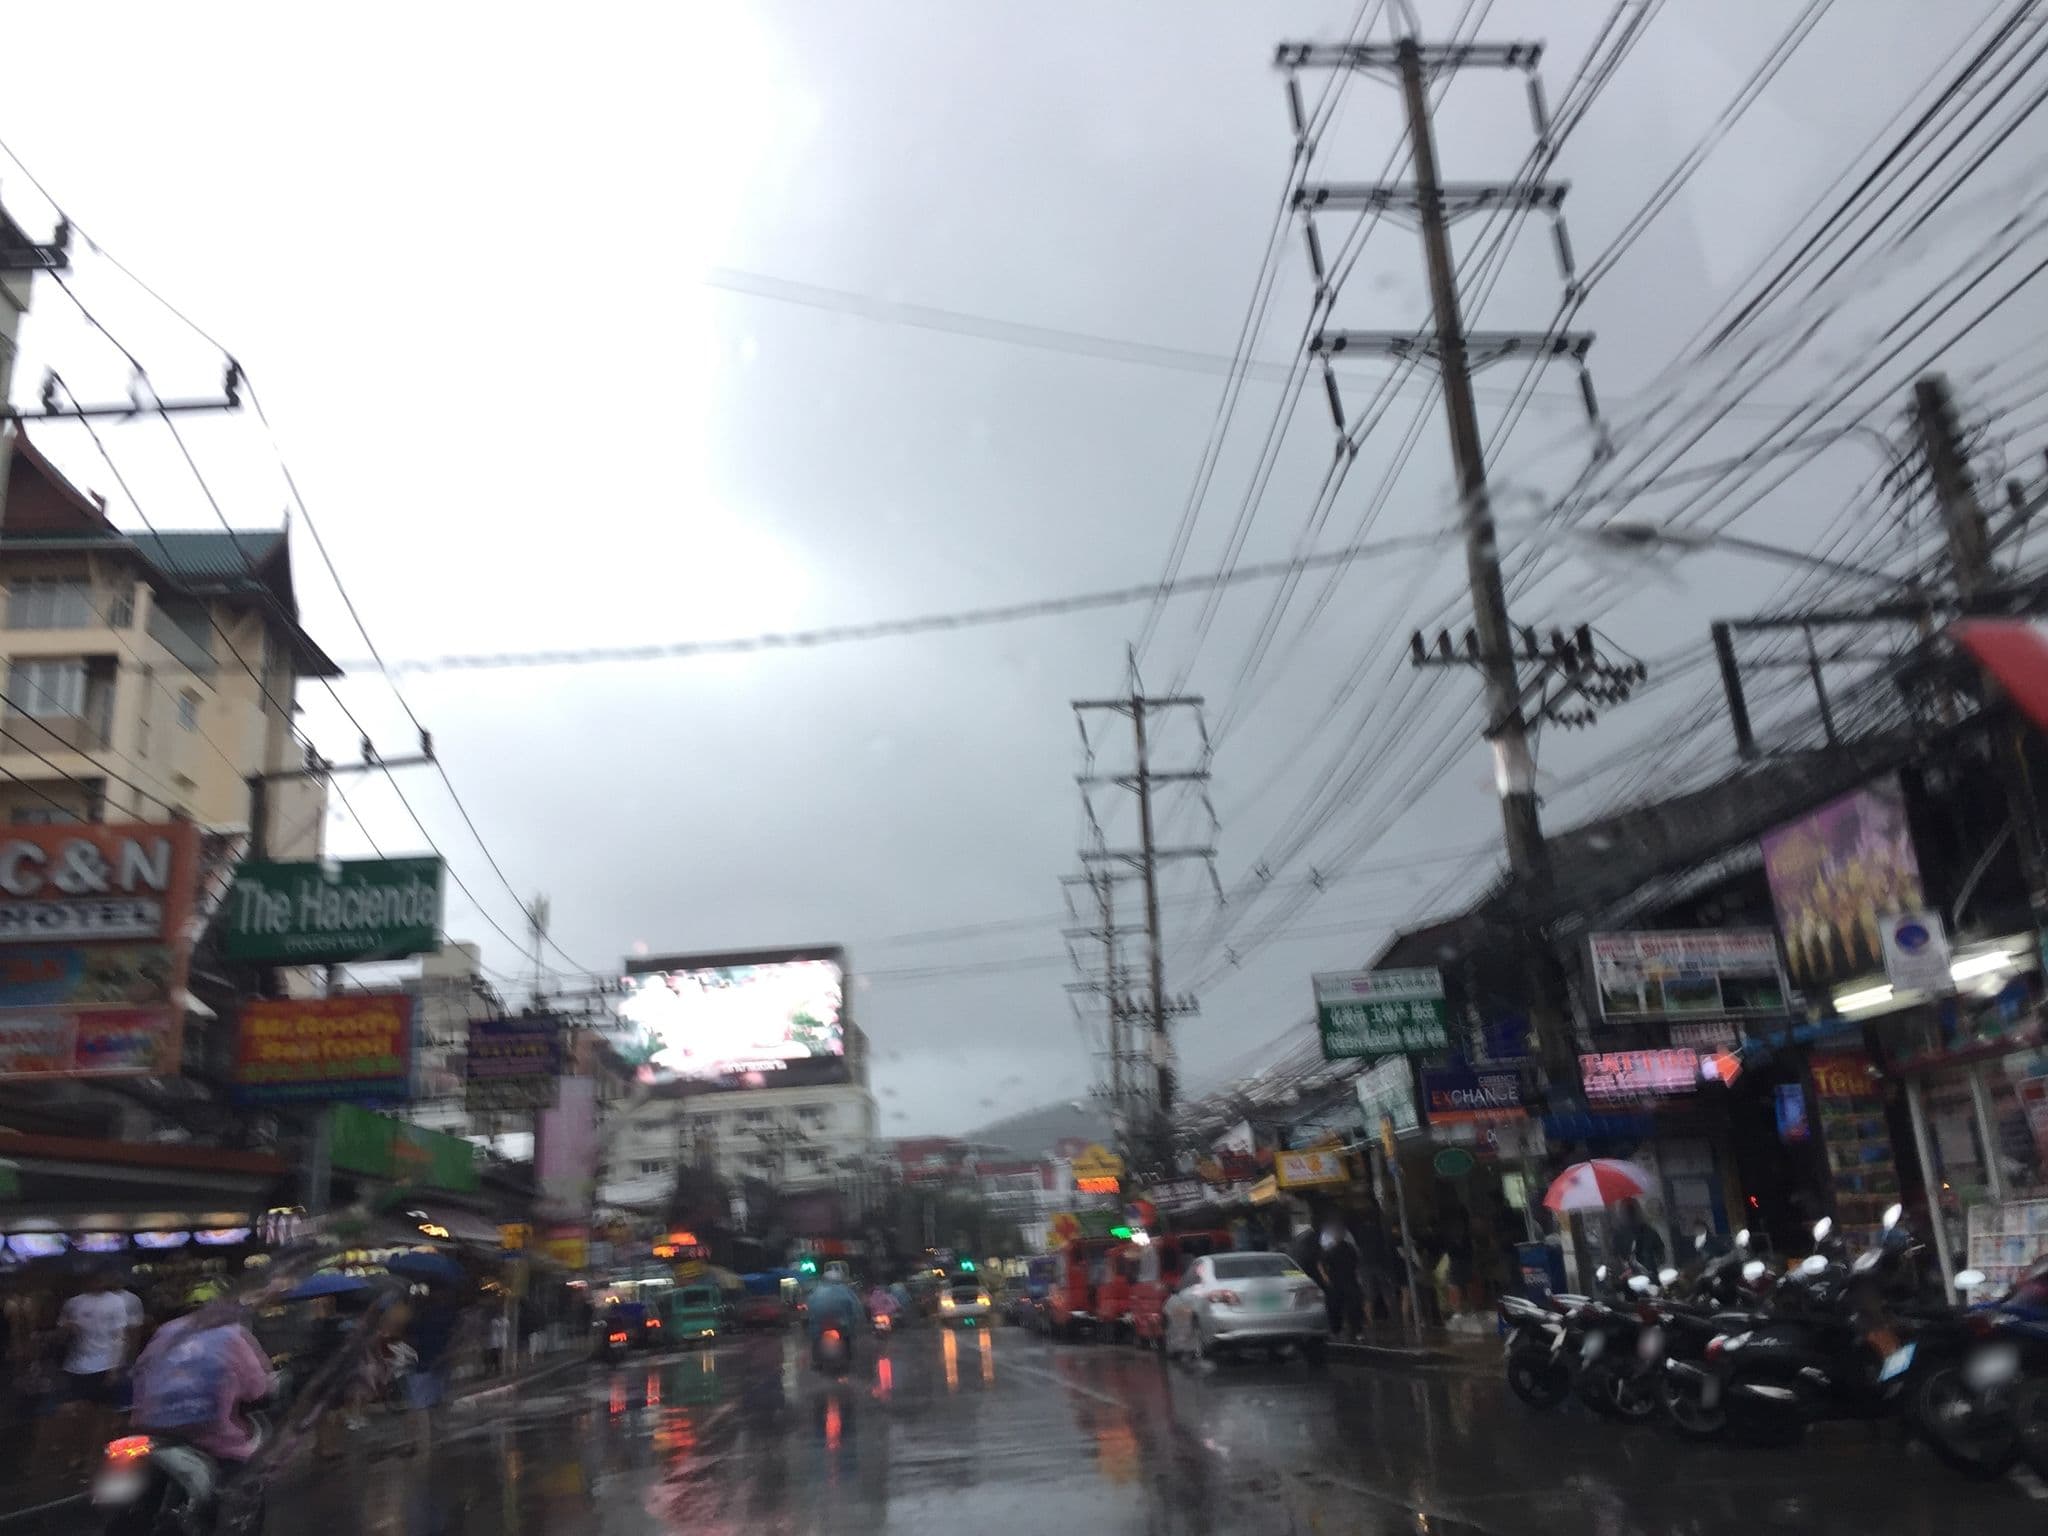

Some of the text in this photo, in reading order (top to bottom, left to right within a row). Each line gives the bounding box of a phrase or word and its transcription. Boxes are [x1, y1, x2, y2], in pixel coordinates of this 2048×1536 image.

[235, 873, 439, 934] The Hacienda
[1431, 1086, 1519, 1107] EXCHANGE
